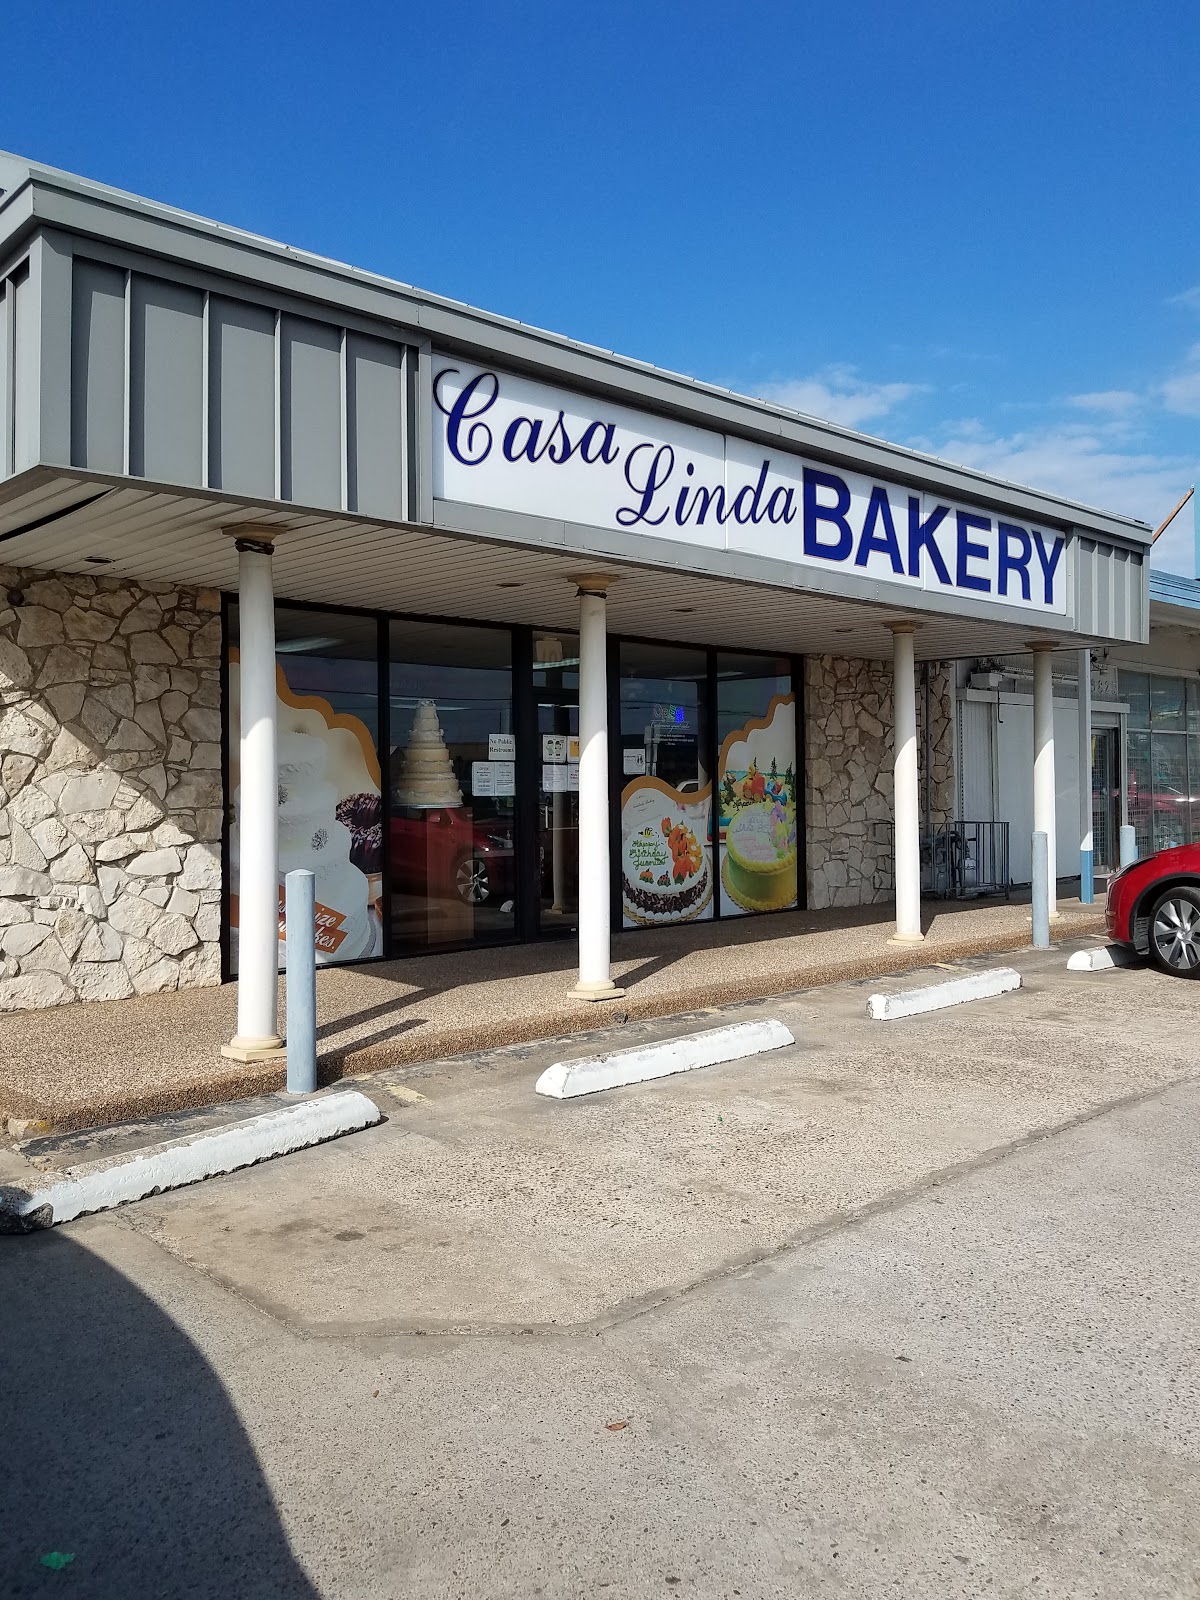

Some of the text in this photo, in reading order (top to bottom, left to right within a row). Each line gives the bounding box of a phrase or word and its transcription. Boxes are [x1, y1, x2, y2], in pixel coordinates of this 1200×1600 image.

[432, 368, 620, 467] Casa
[615, 443, 798, 527] Linda
[802, 466, 1065, 605] BAKERY
